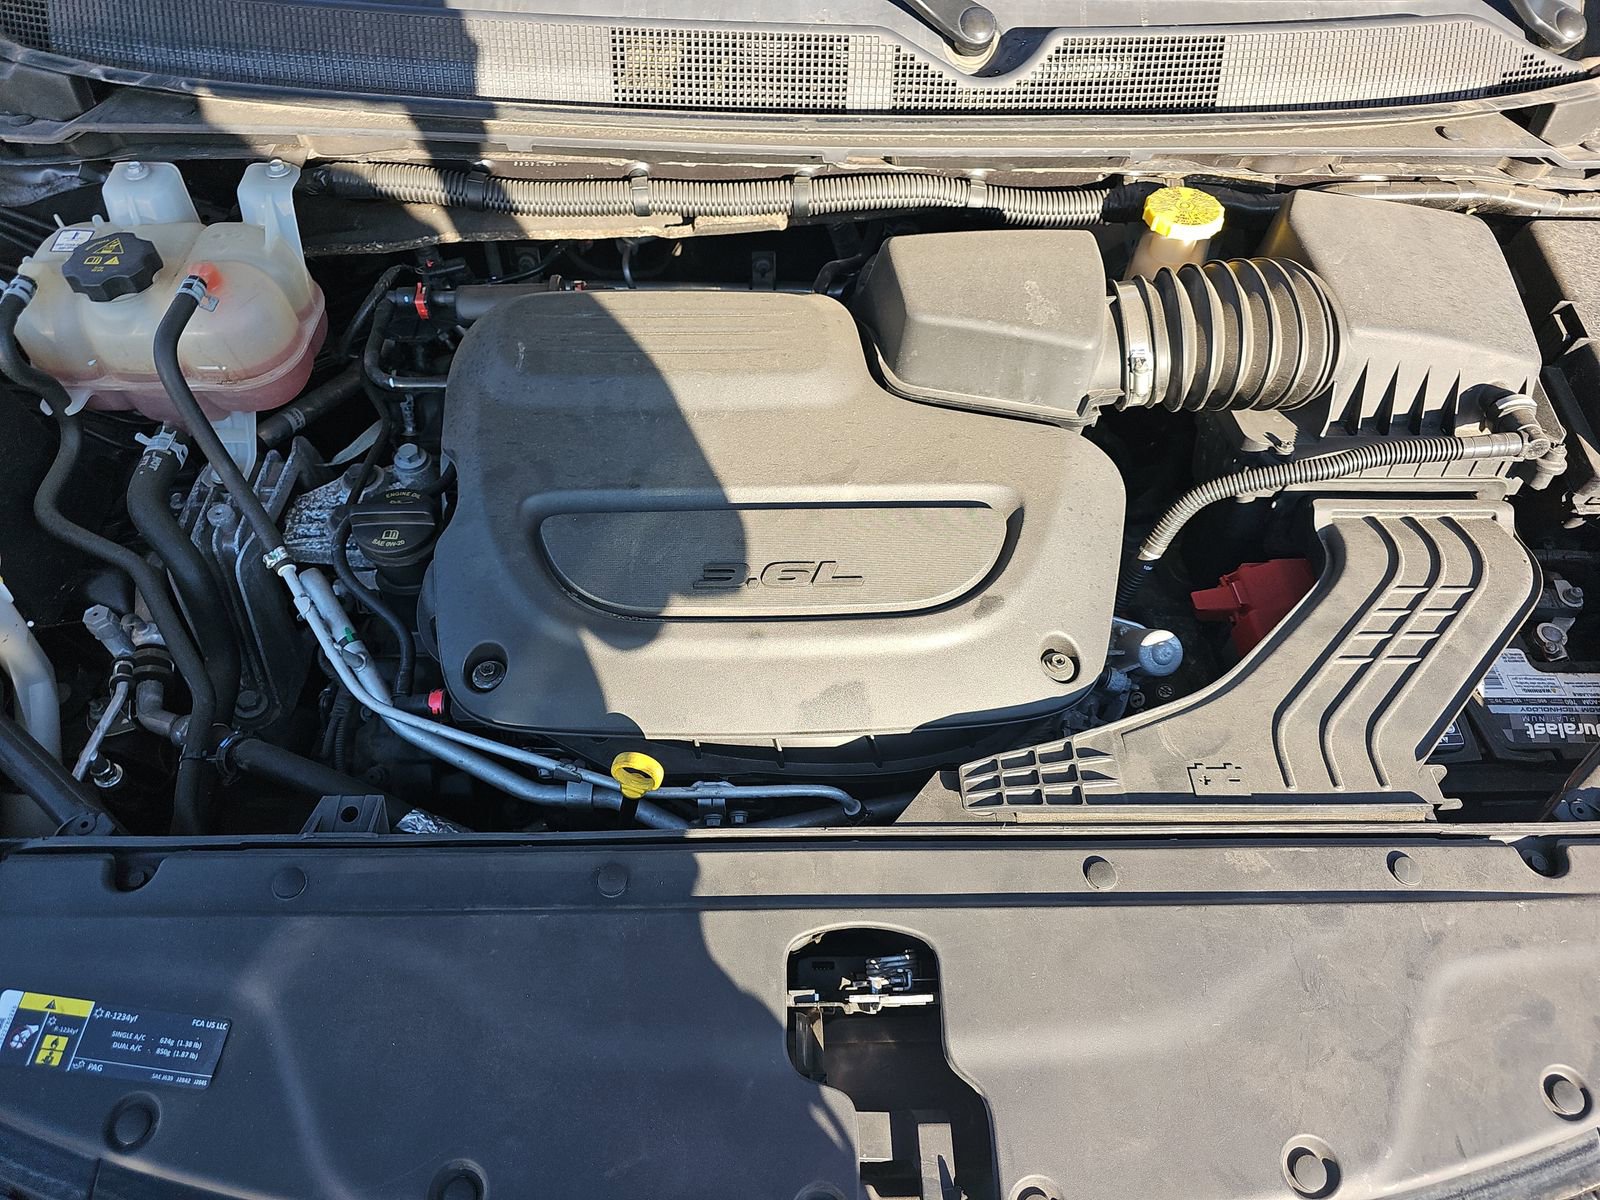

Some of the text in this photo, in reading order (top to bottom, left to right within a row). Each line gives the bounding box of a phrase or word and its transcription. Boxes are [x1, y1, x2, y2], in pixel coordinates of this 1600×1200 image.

[385, 491, 410, 499] ENGINE
[372, 539, 405, 547] SAE 0W-20
[692, 560, 866, 590] 3.6L
[105, 1010, 228, 1030] R-1234yf FCA US LLC
[112, 1030, 202, 1050] SINGLE A/C 624g (1.38 lb)
[112, 1041, 199, 1060] DUAL A/C 850g (1.87 lb)
[88, 1063, 103, 1072] PAG
